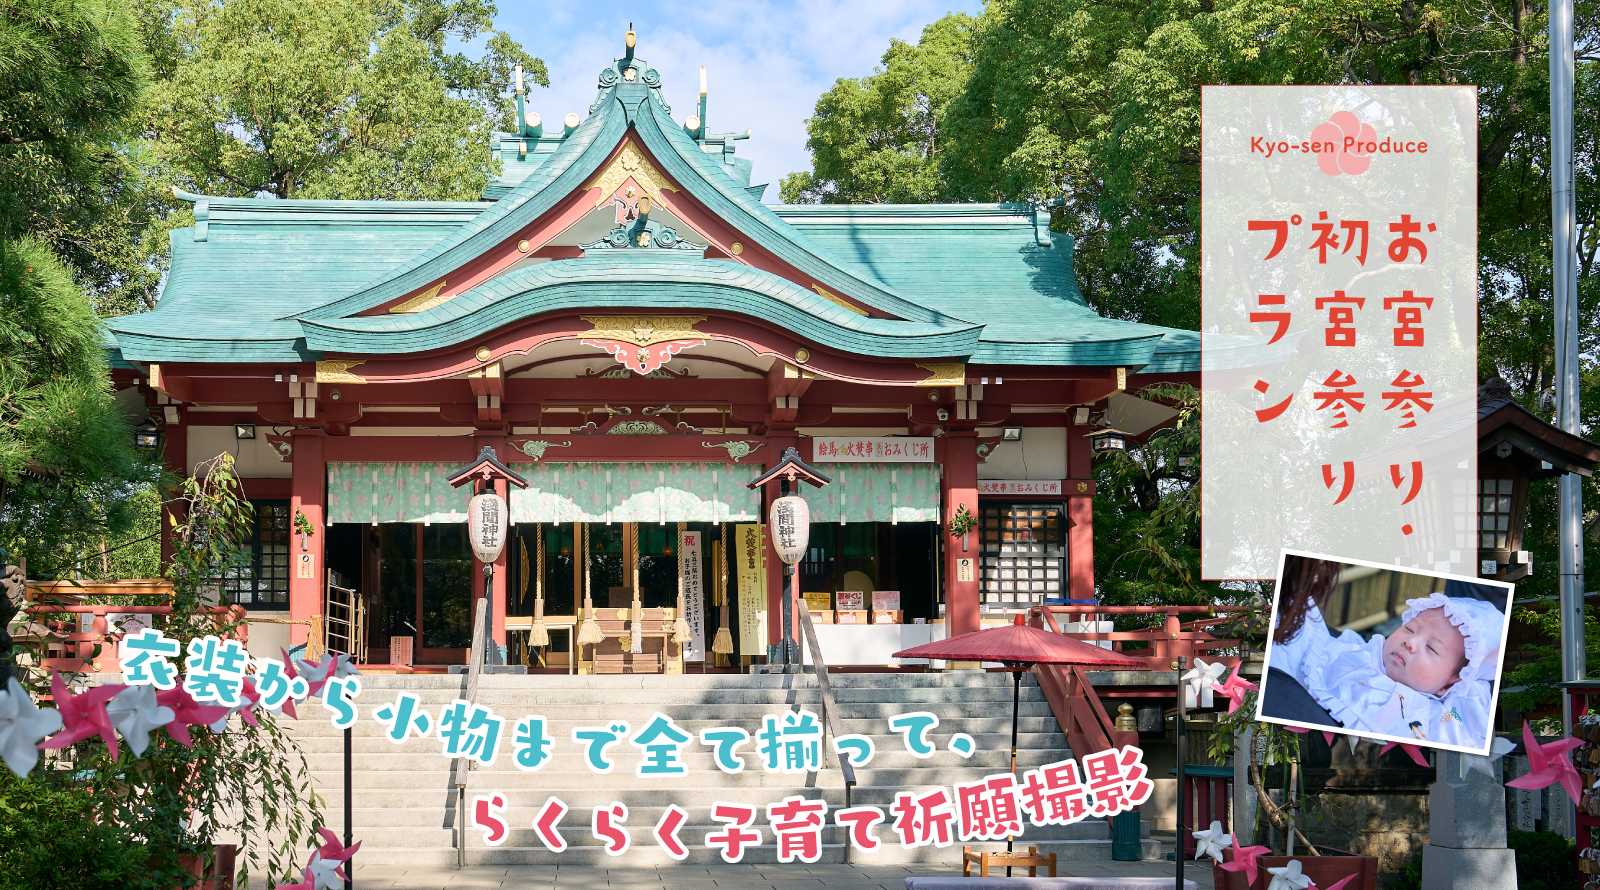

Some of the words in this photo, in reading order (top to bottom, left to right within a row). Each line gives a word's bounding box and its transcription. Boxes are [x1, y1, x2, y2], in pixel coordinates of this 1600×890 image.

[818, 441, 837, 457] 絵馬
[884, 441, 929, 457] おみくじ所
[1017, 482, 1057, 493] おみくじ所
[684, 535, 696, 546] 祝
